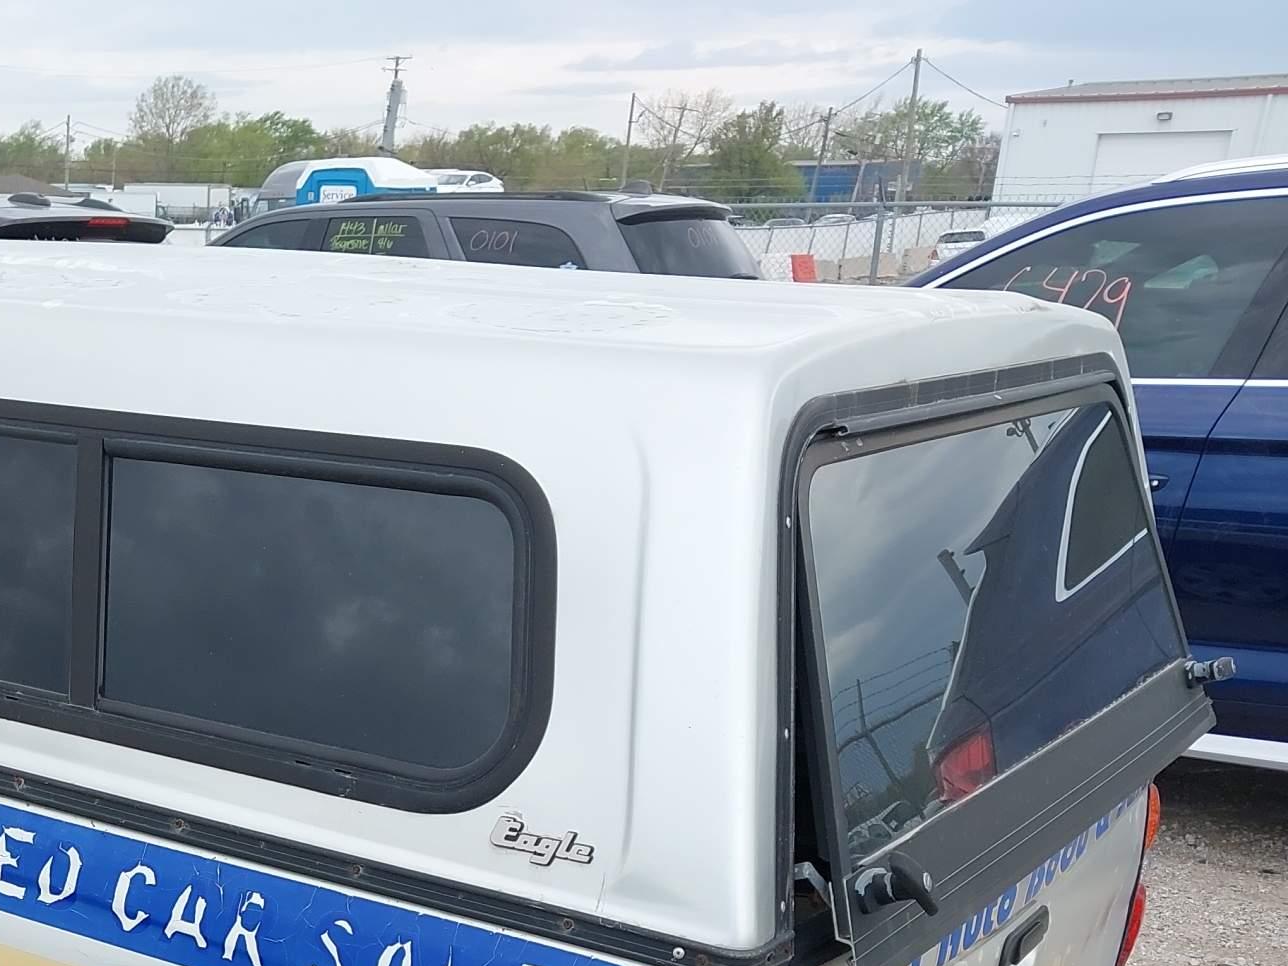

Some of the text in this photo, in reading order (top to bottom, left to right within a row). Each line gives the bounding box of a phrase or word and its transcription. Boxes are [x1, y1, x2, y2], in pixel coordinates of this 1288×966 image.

[322, 188, 354, 200] Service
[470, 230, 518, 255] 0101
[490, 815, 598, 867] Eagle
